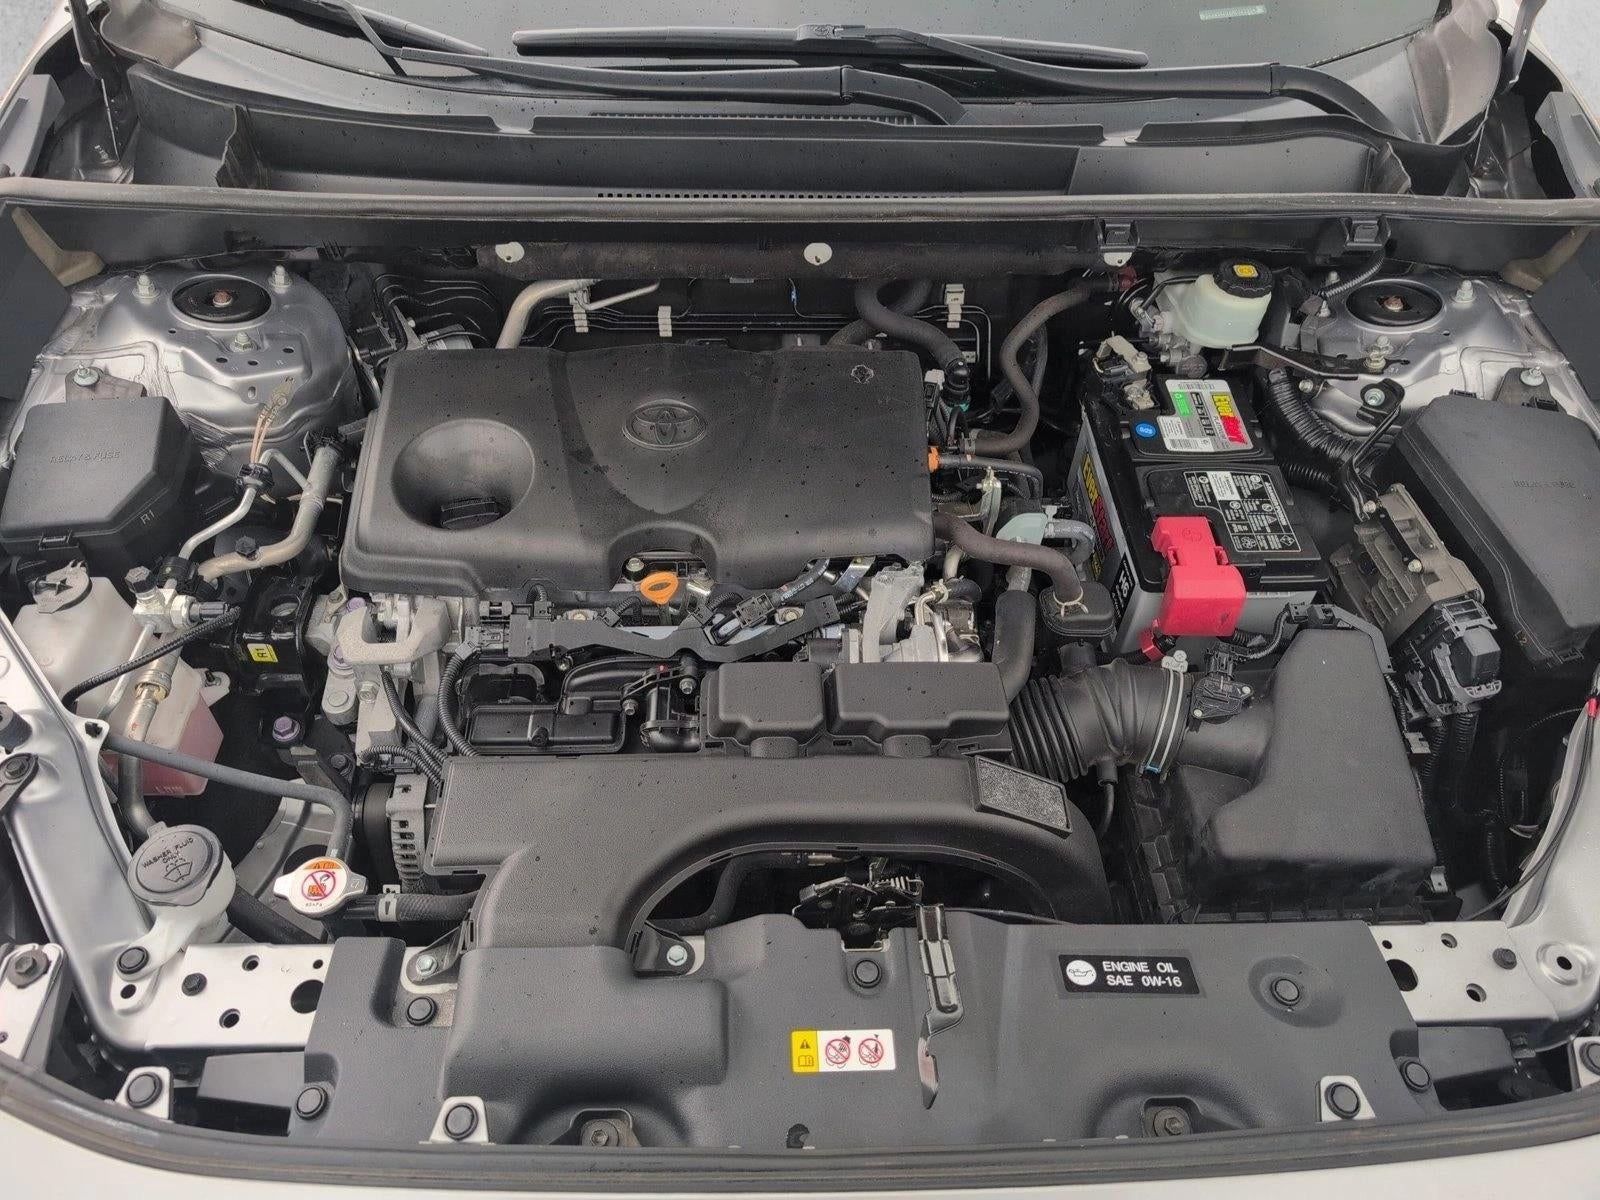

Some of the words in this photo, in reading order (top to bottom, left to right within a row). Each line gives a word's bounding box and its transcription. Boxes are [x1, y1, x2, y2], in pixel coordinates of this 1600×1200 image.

[140, 509, 155, 525] R1
[141, 849, 172, 868] WASHER
[175, 837, 194, 850] FLUID
[162, 851, 180, 864] ONLY
[1102, 961, 1150, 973] ENGINE
[1156, 962, 1179, 974] OIL
[1106, 975, 1134, 987] SAE
[1141, 976, 1183, 987] 0W-16
